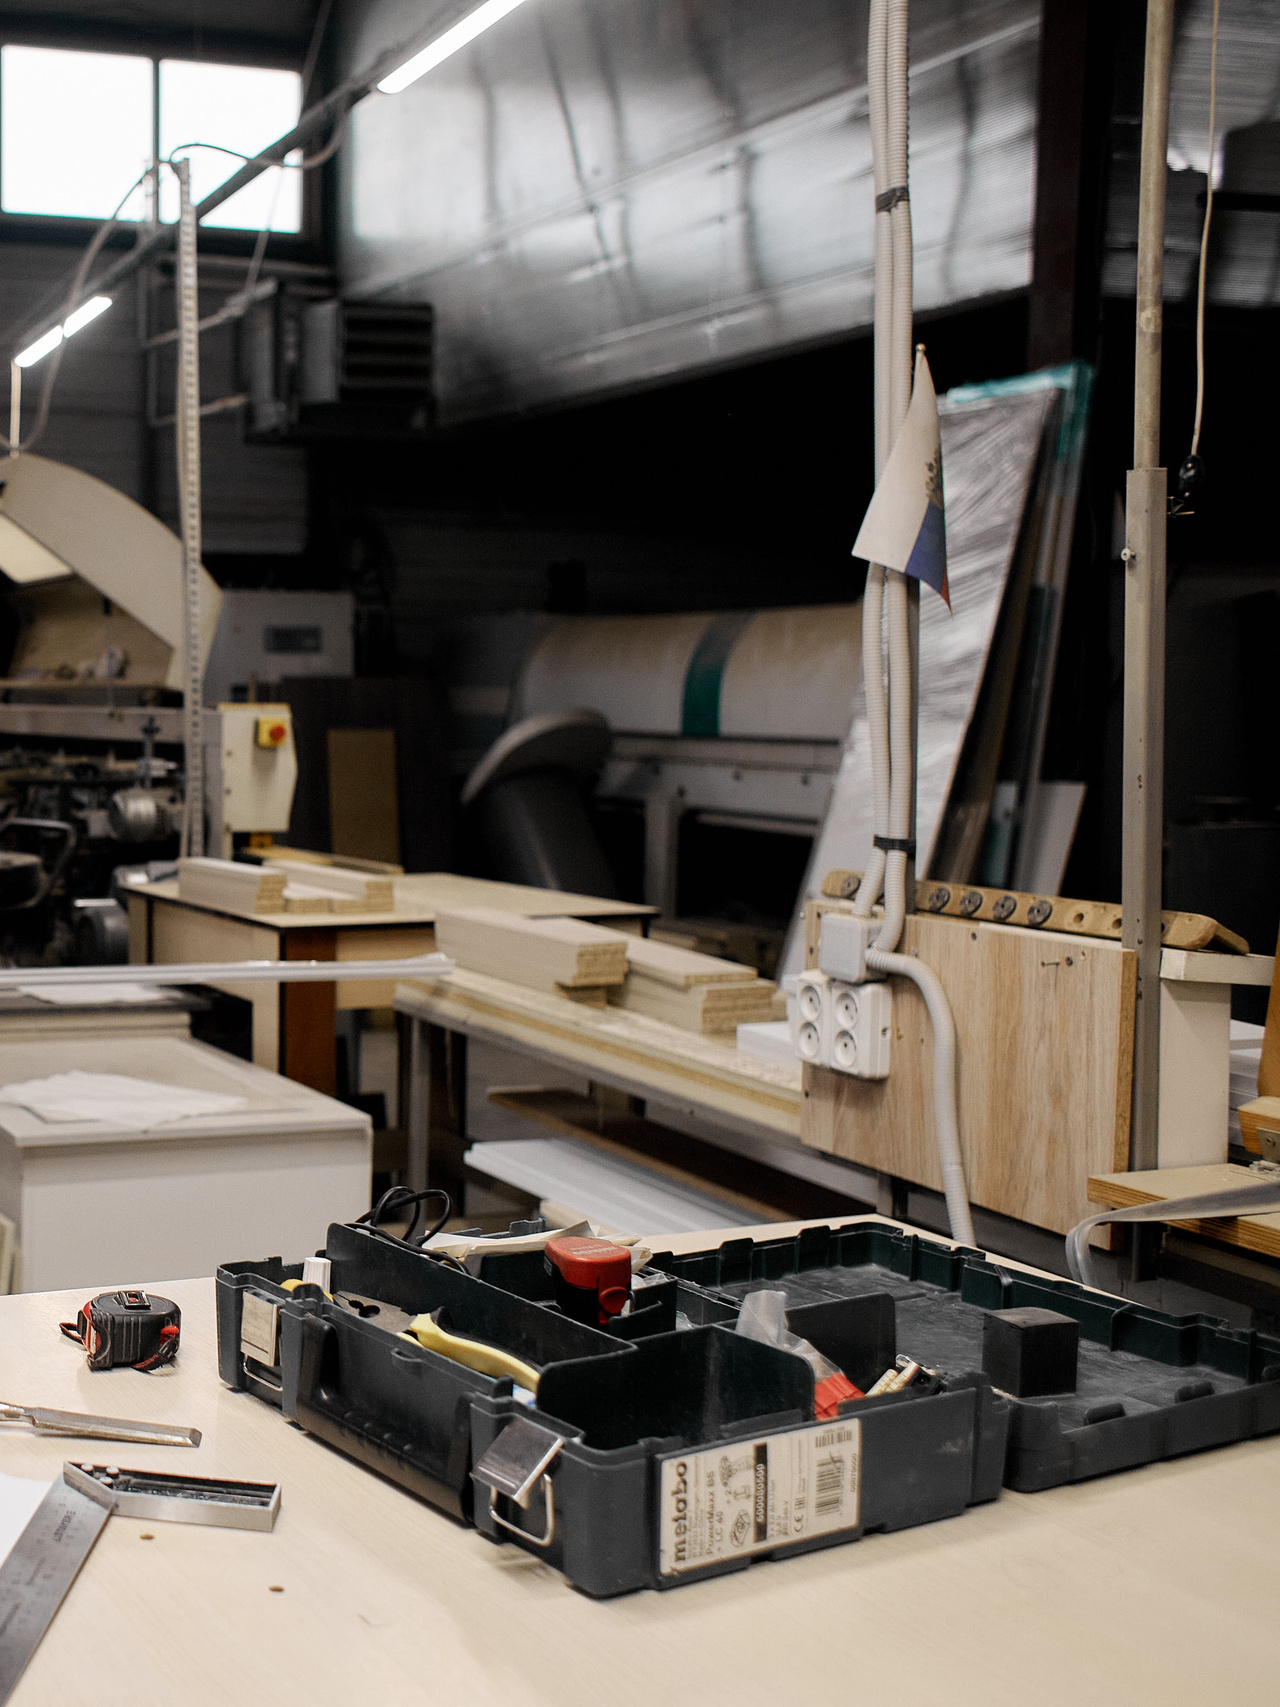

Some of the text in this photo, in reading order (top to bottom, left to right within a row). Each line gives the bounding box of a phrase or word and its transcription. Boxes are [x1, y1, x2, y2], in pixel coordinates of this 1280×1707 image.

[671, 1461, 687, 1563] metabo
[705, 1469, 714, 1555] PowerMaxx BS
[756, 1463, 764, 1522] 600080500
[715, 1526, 722, 1542] LC
